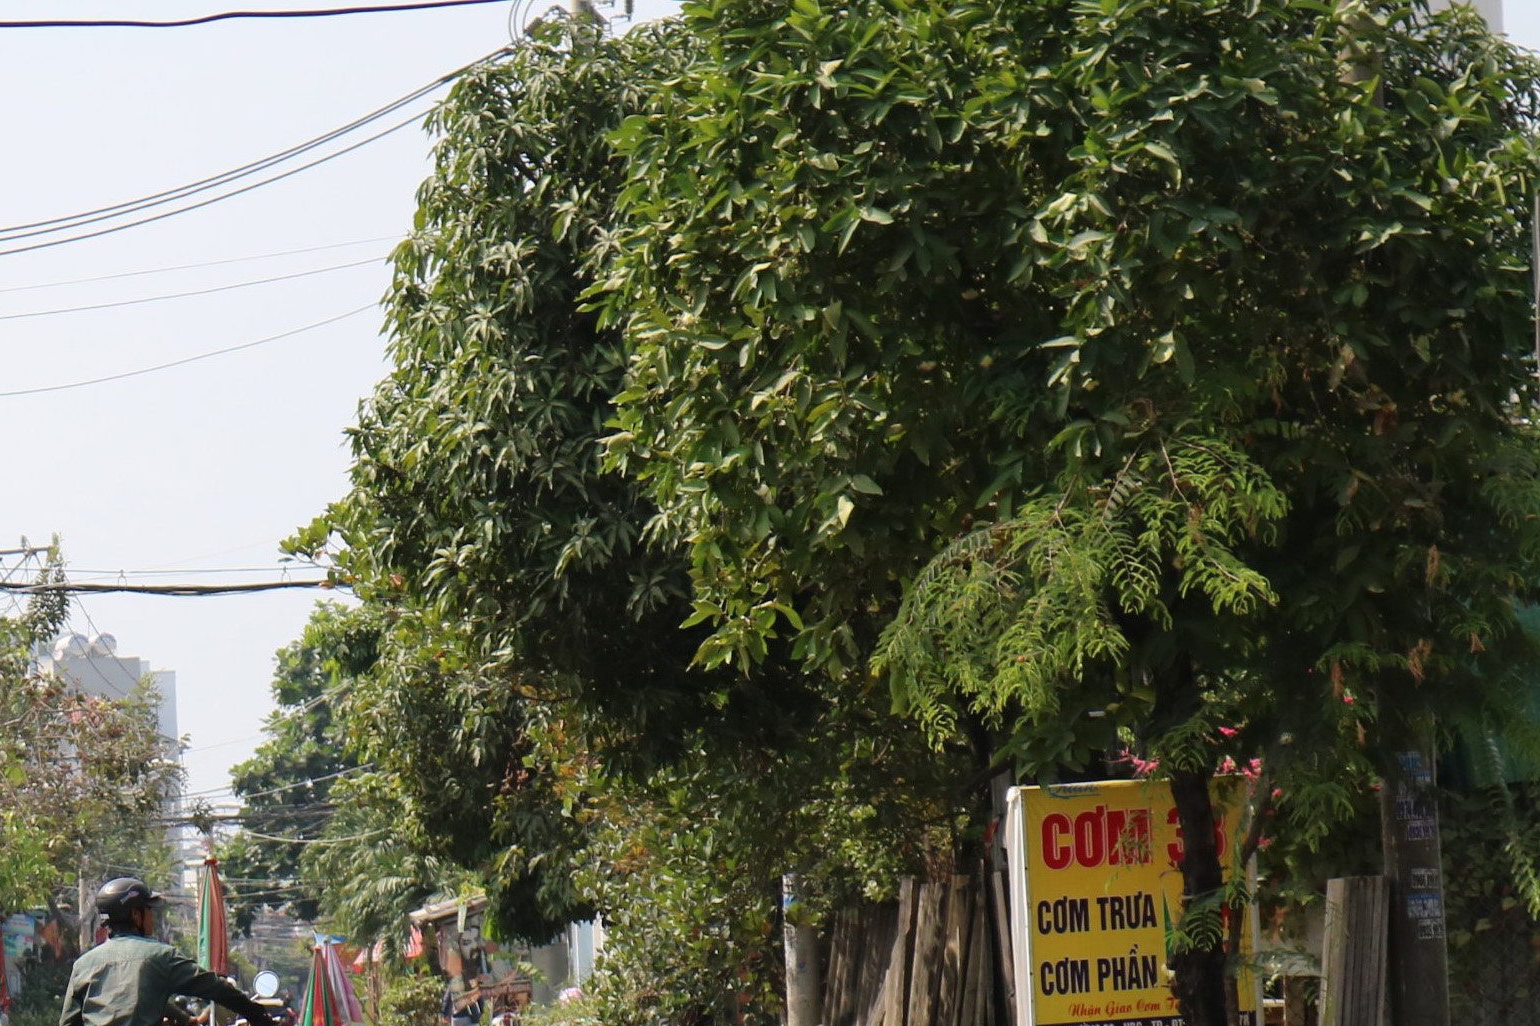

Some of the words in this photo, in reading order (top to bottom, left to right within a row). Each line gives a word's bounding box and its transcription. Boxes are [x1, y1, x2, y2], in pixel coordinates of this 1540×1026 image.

[1042, 804, 1153, 870] CƠM
[1037, 896, 1090, 935] CƠM
[1096, 891, 1157, 930] TRƯA
[1040, 957, 1090, 996] CƠM
[1097, 944, 1158, 992] PHẦN
[1105, 1000, 1132, 1018] Giao
